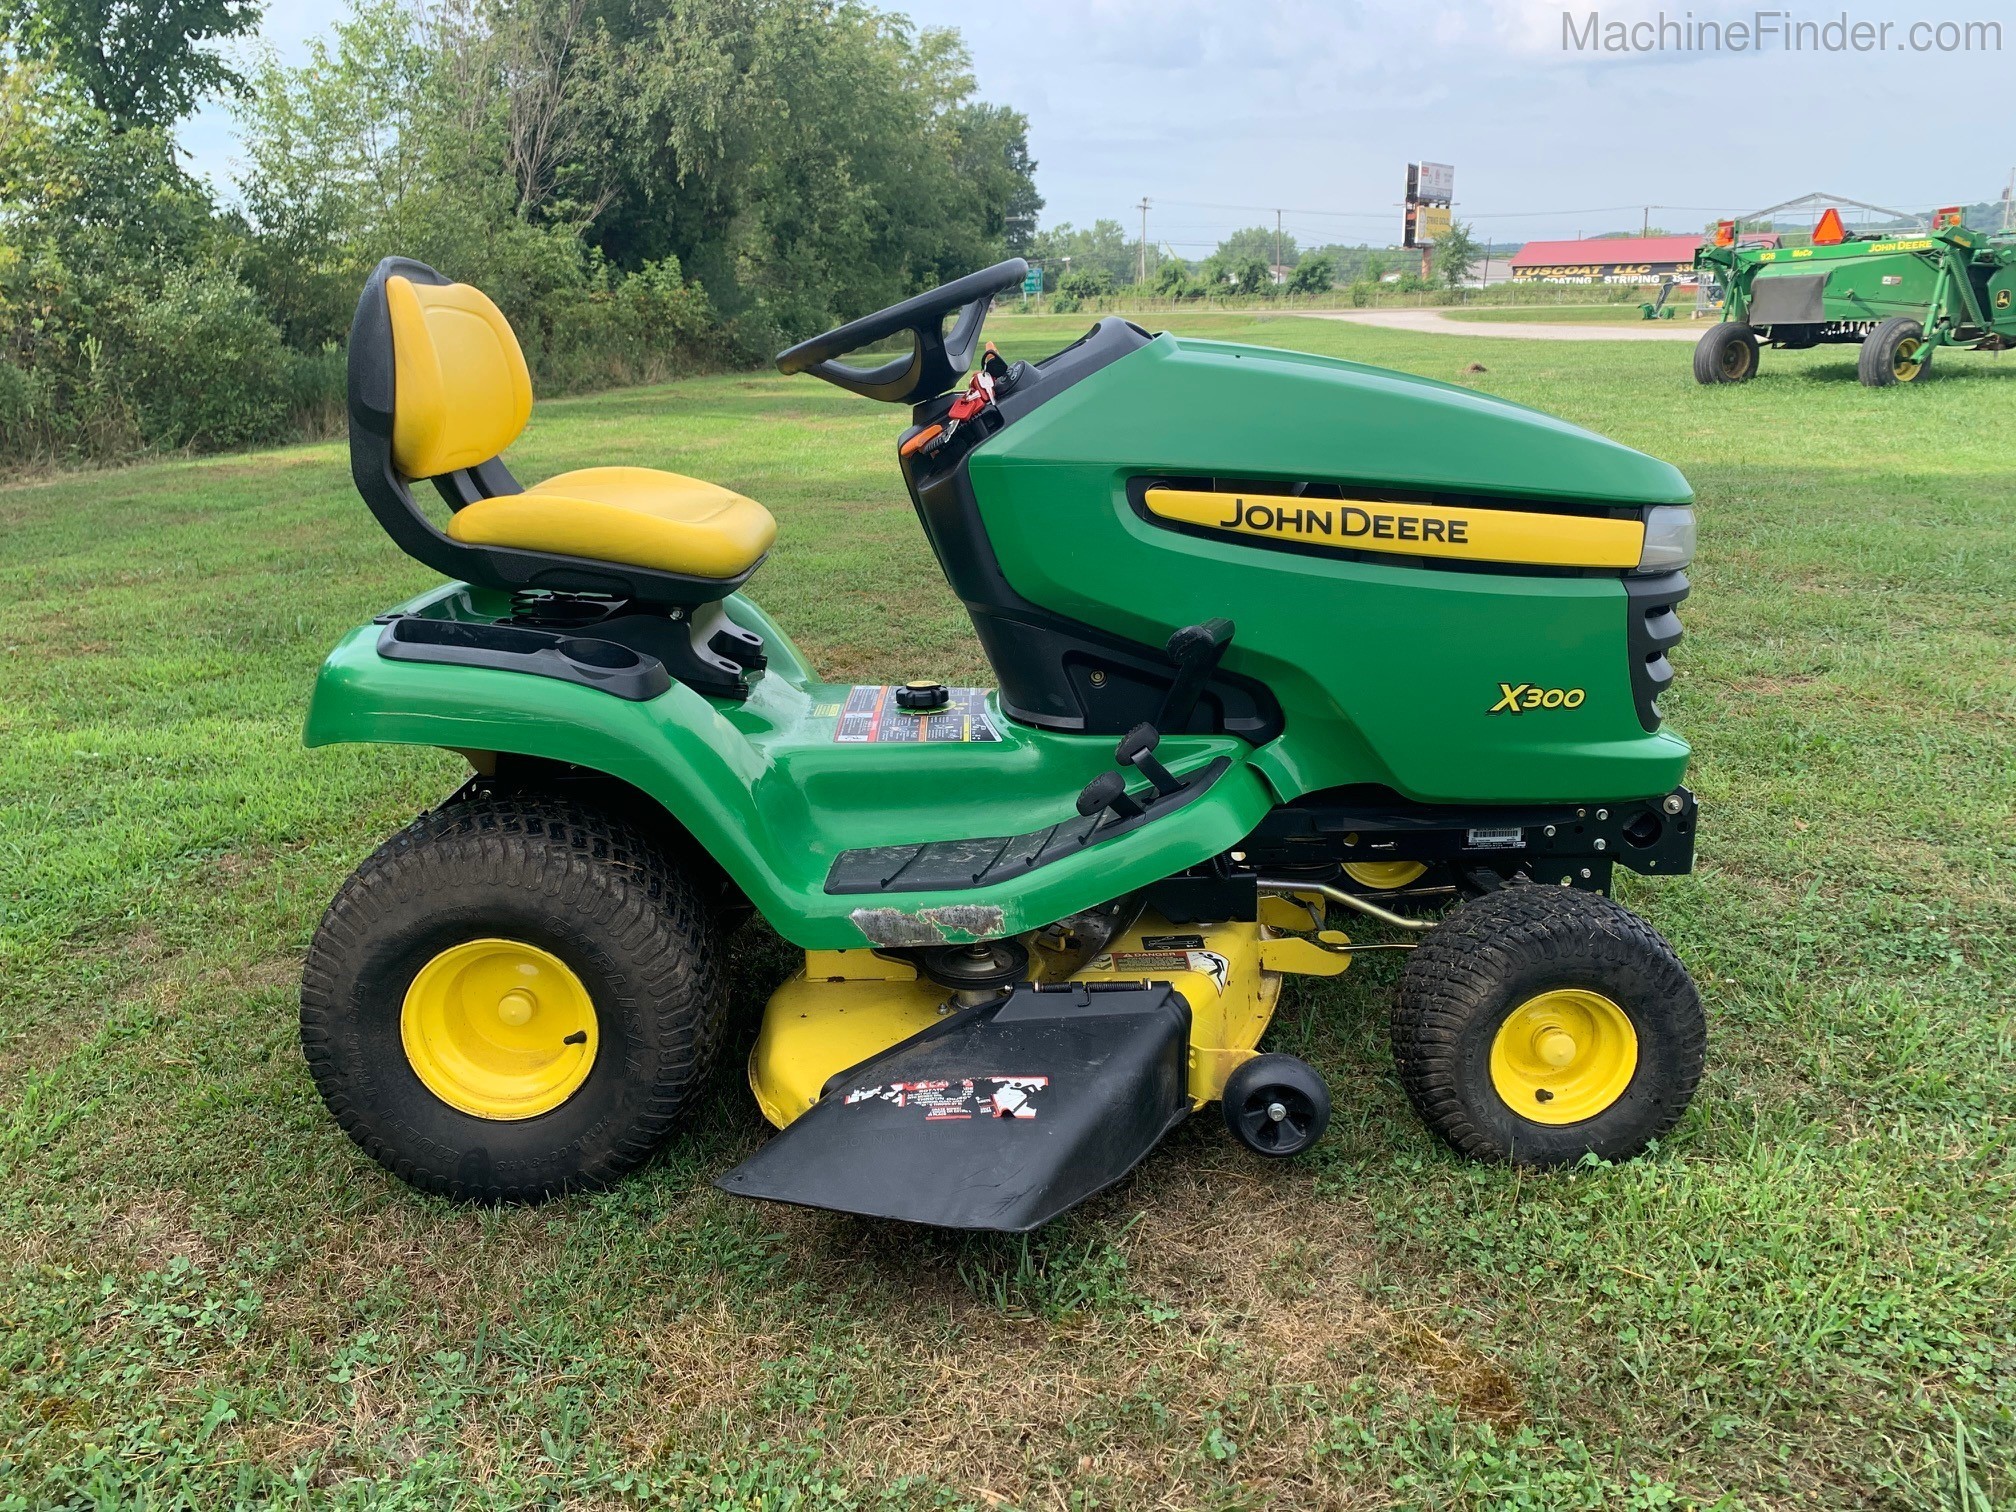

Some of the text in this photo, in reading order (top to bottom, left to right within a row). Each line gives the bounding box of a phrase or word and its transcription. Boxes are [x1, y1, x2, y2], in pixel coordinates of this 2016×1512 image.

[1868, 240, 1933, 253] JOHN DEERE
[1515, 266, 1604, 276] TUSCOAT
[1613, 264, 1652, 274] LLC
[1543, 276, 1592, 285] COATING
[1604, 274, 1660, 284] STRIPING
[1219, 498, 1469, 544] JOHN DEERE
[1487, 682, 1586, 713] X300
[543, 915, 646, 1086] CARLISLE
